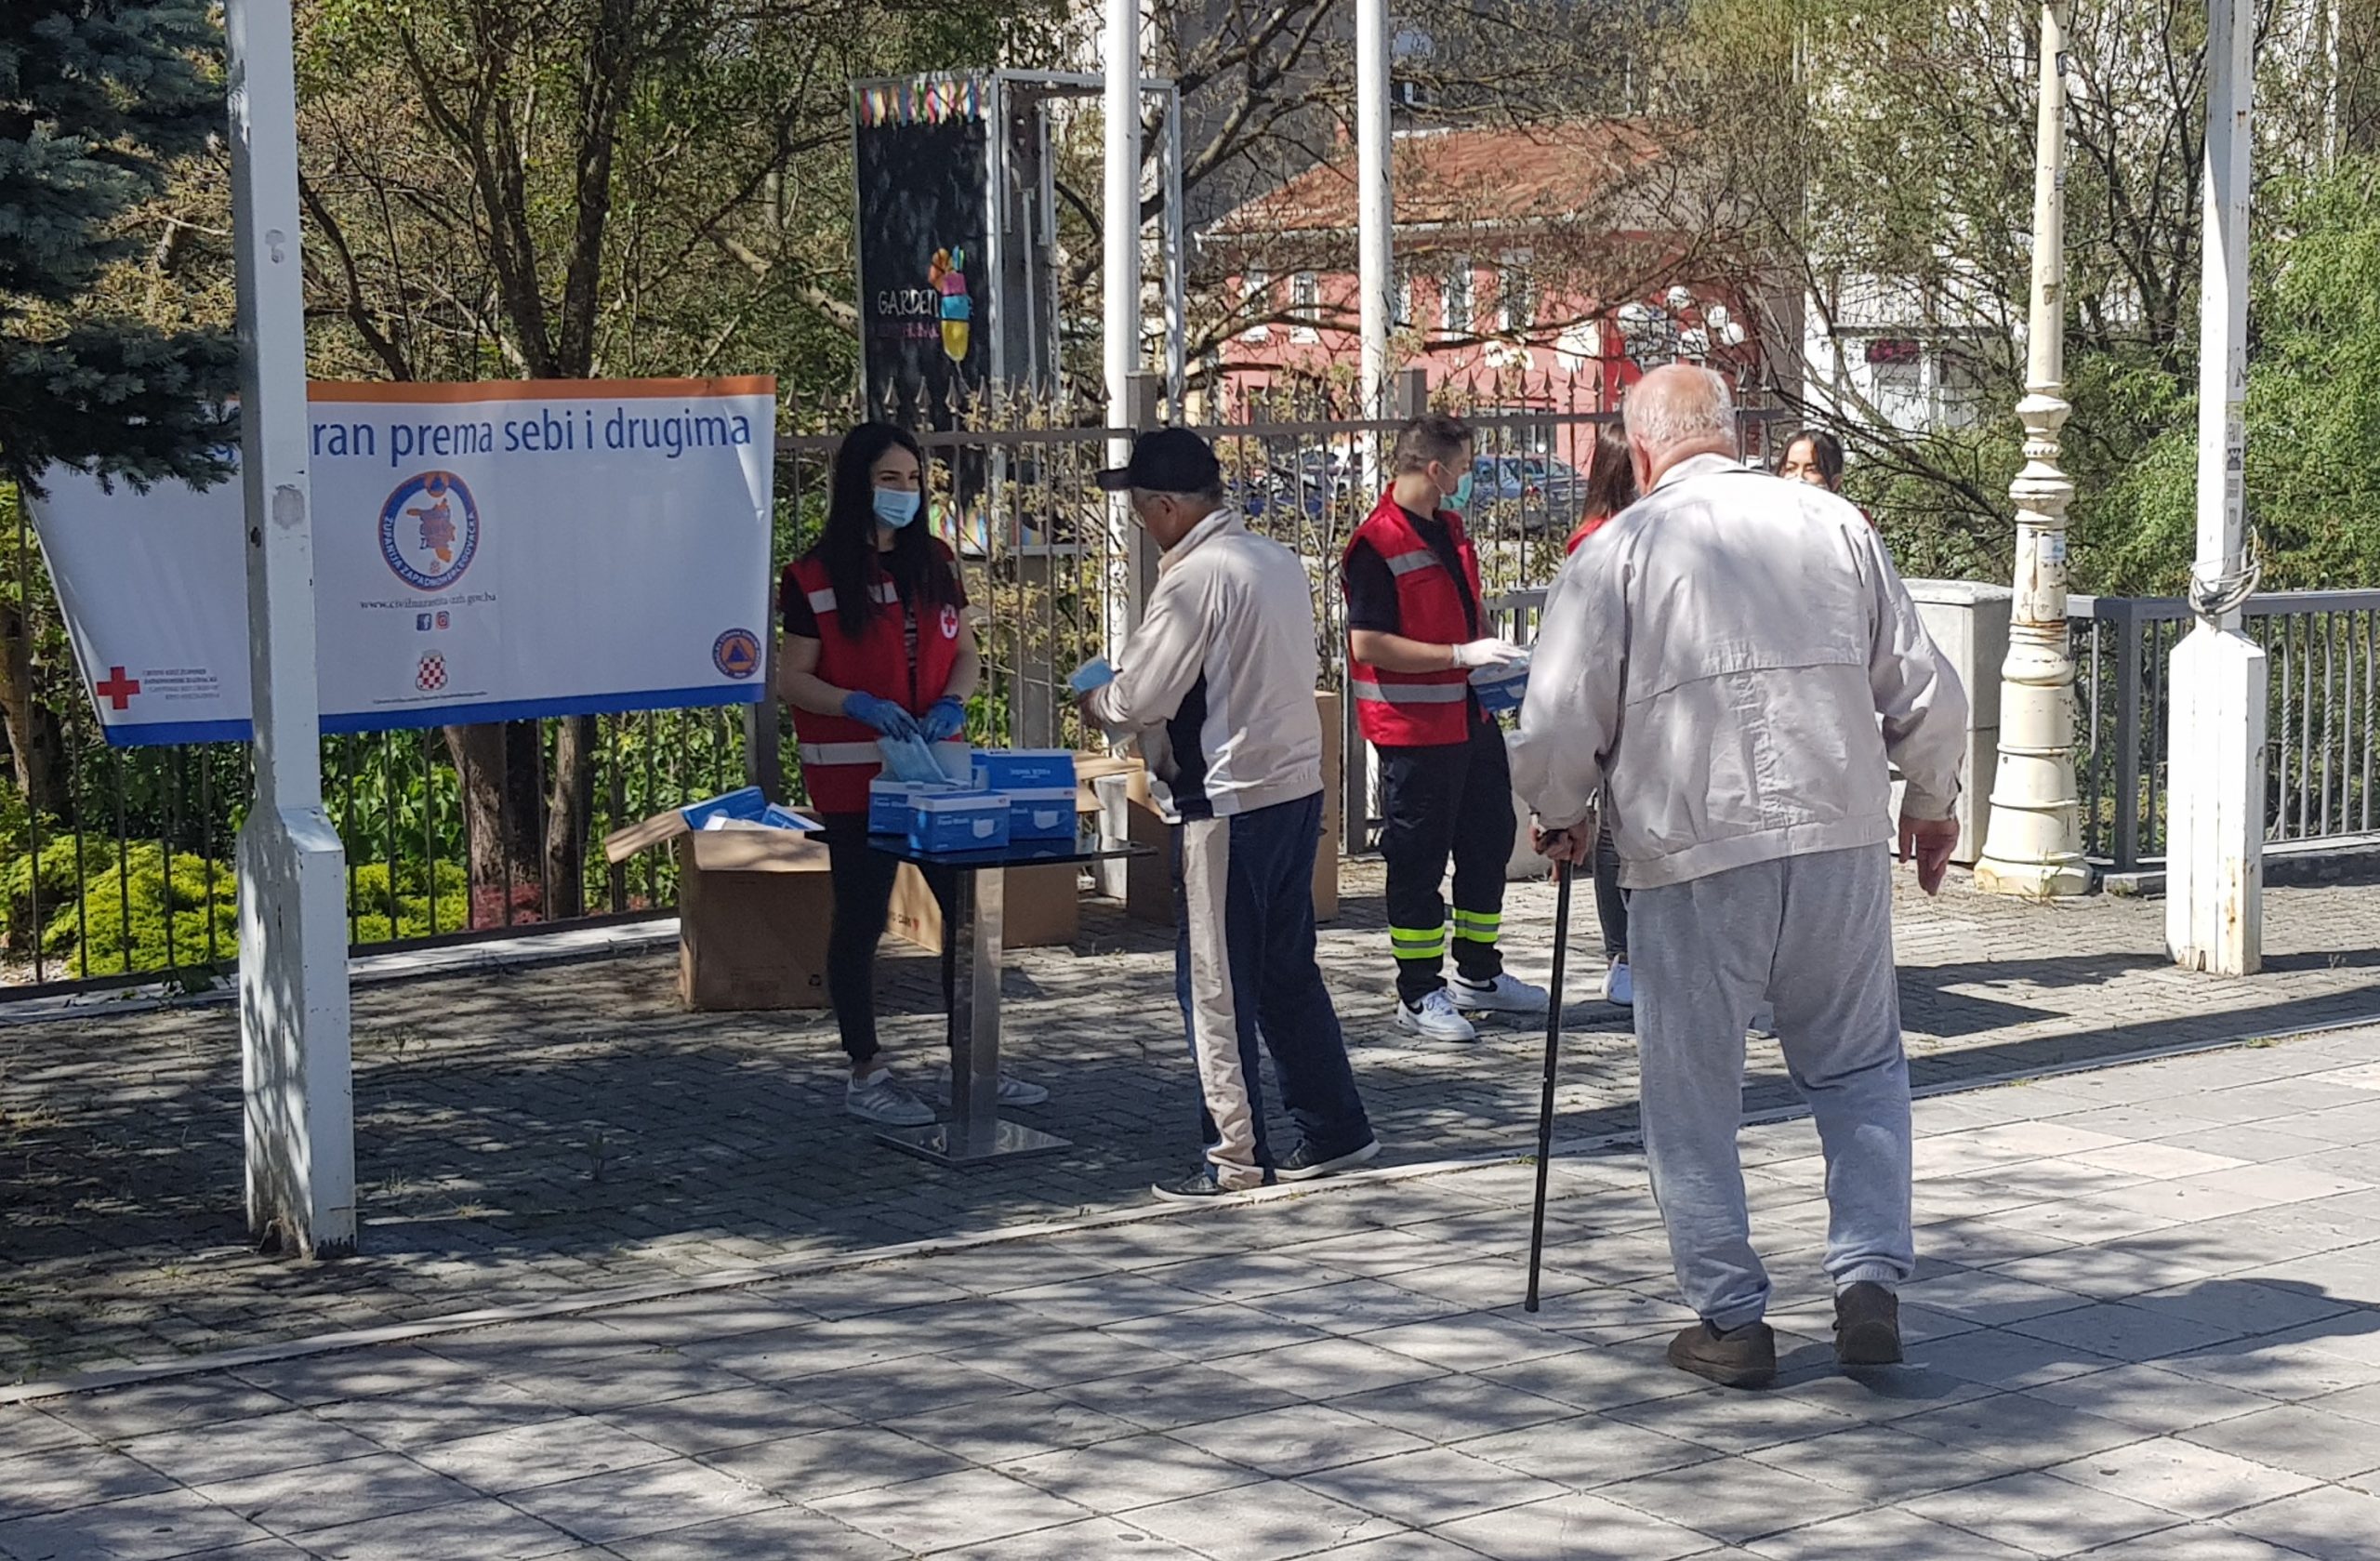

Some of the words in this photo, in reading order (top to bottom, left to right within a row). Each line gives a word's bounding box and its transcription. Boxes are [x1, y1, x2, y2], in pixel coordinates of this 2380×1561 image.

[390, 420, 493, 467] prema
[505, 408, 575, 453] sebi
[586, 410, 594, 450] i
[605, 407, 751, 458] drugima
